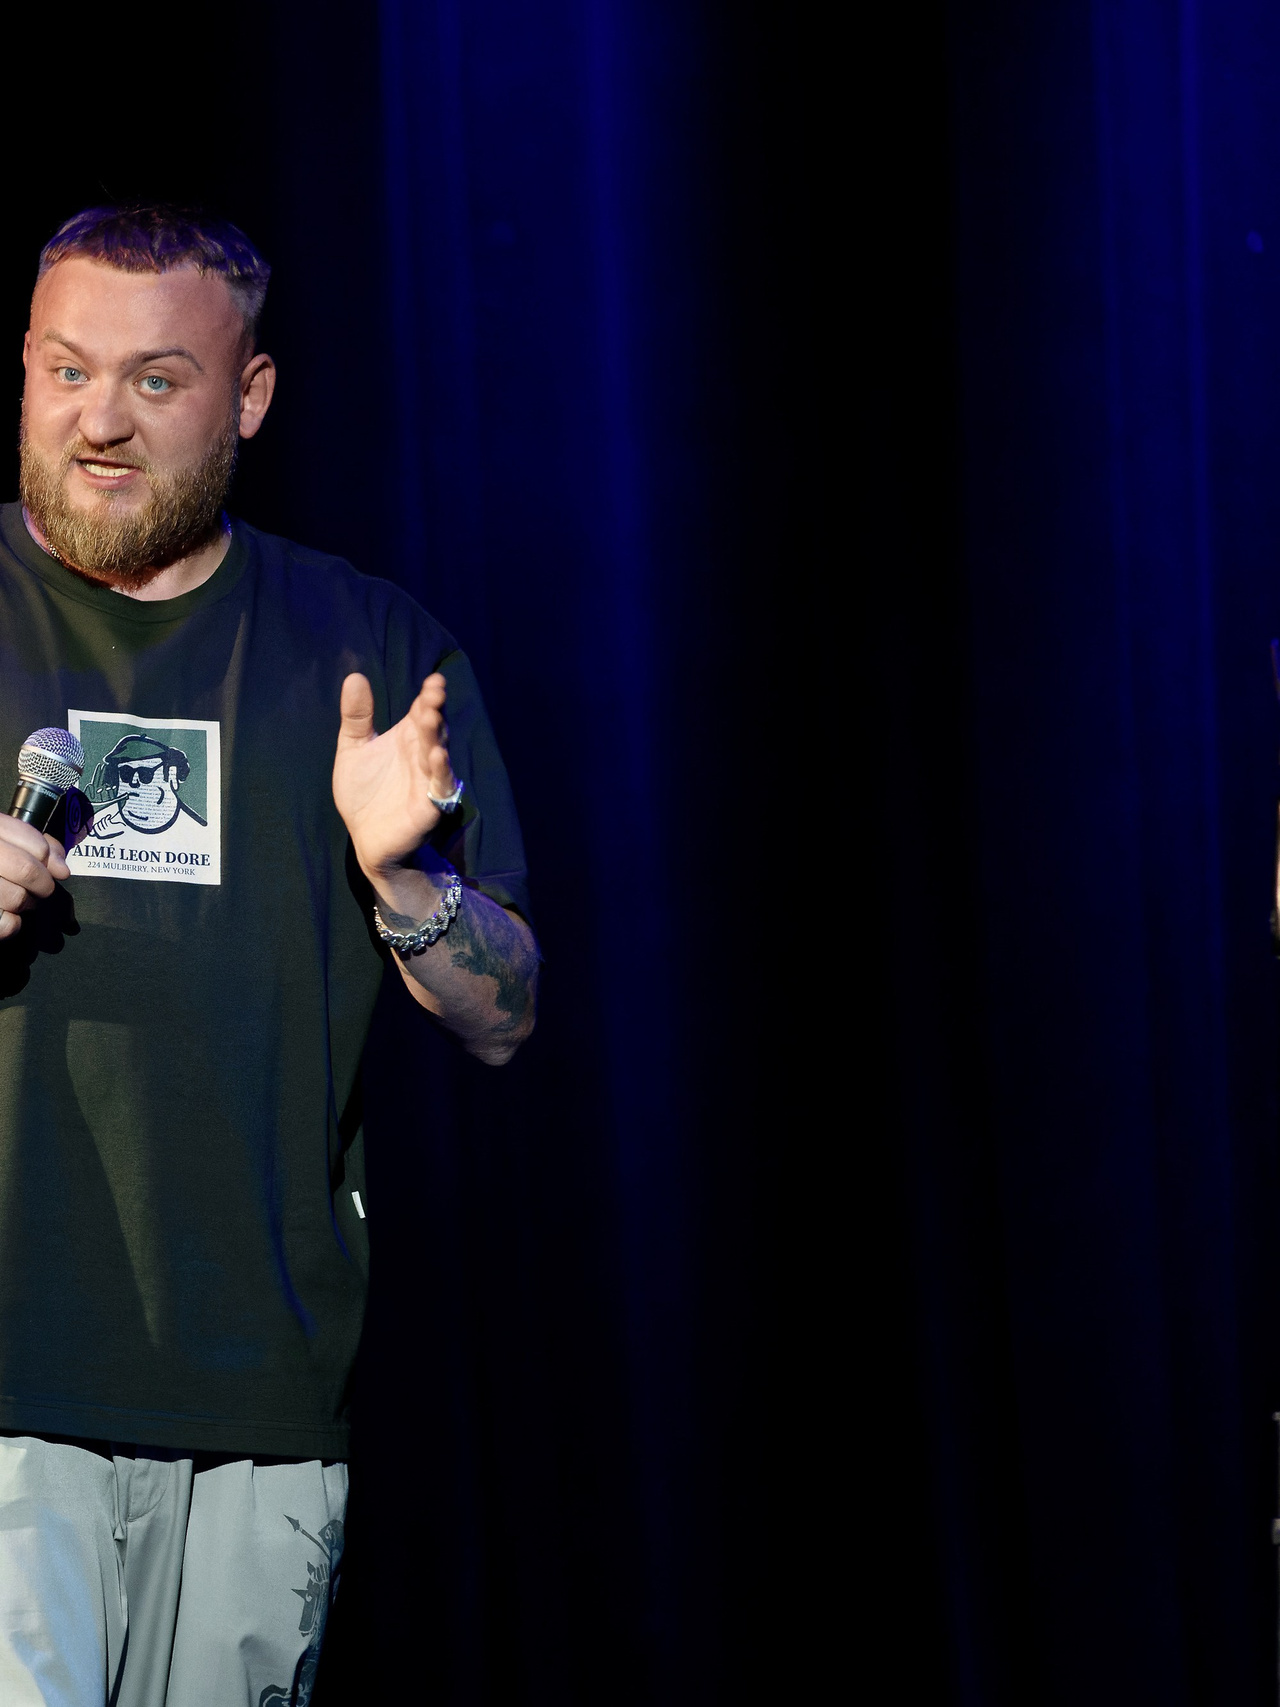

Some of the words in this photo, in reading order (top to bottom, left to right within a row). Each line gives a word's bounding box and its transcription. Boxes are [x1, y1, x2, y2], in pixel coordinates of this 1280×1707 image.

[72, 843, 116, 859] AIMÉ
[119, 848, 161, 862] LEON
[165, 851, 210, 866] DORE
[87, 861, 101, 869] 224
[150, 866, 171, 874] NEW
[172, 867, 195, 876] YORK
